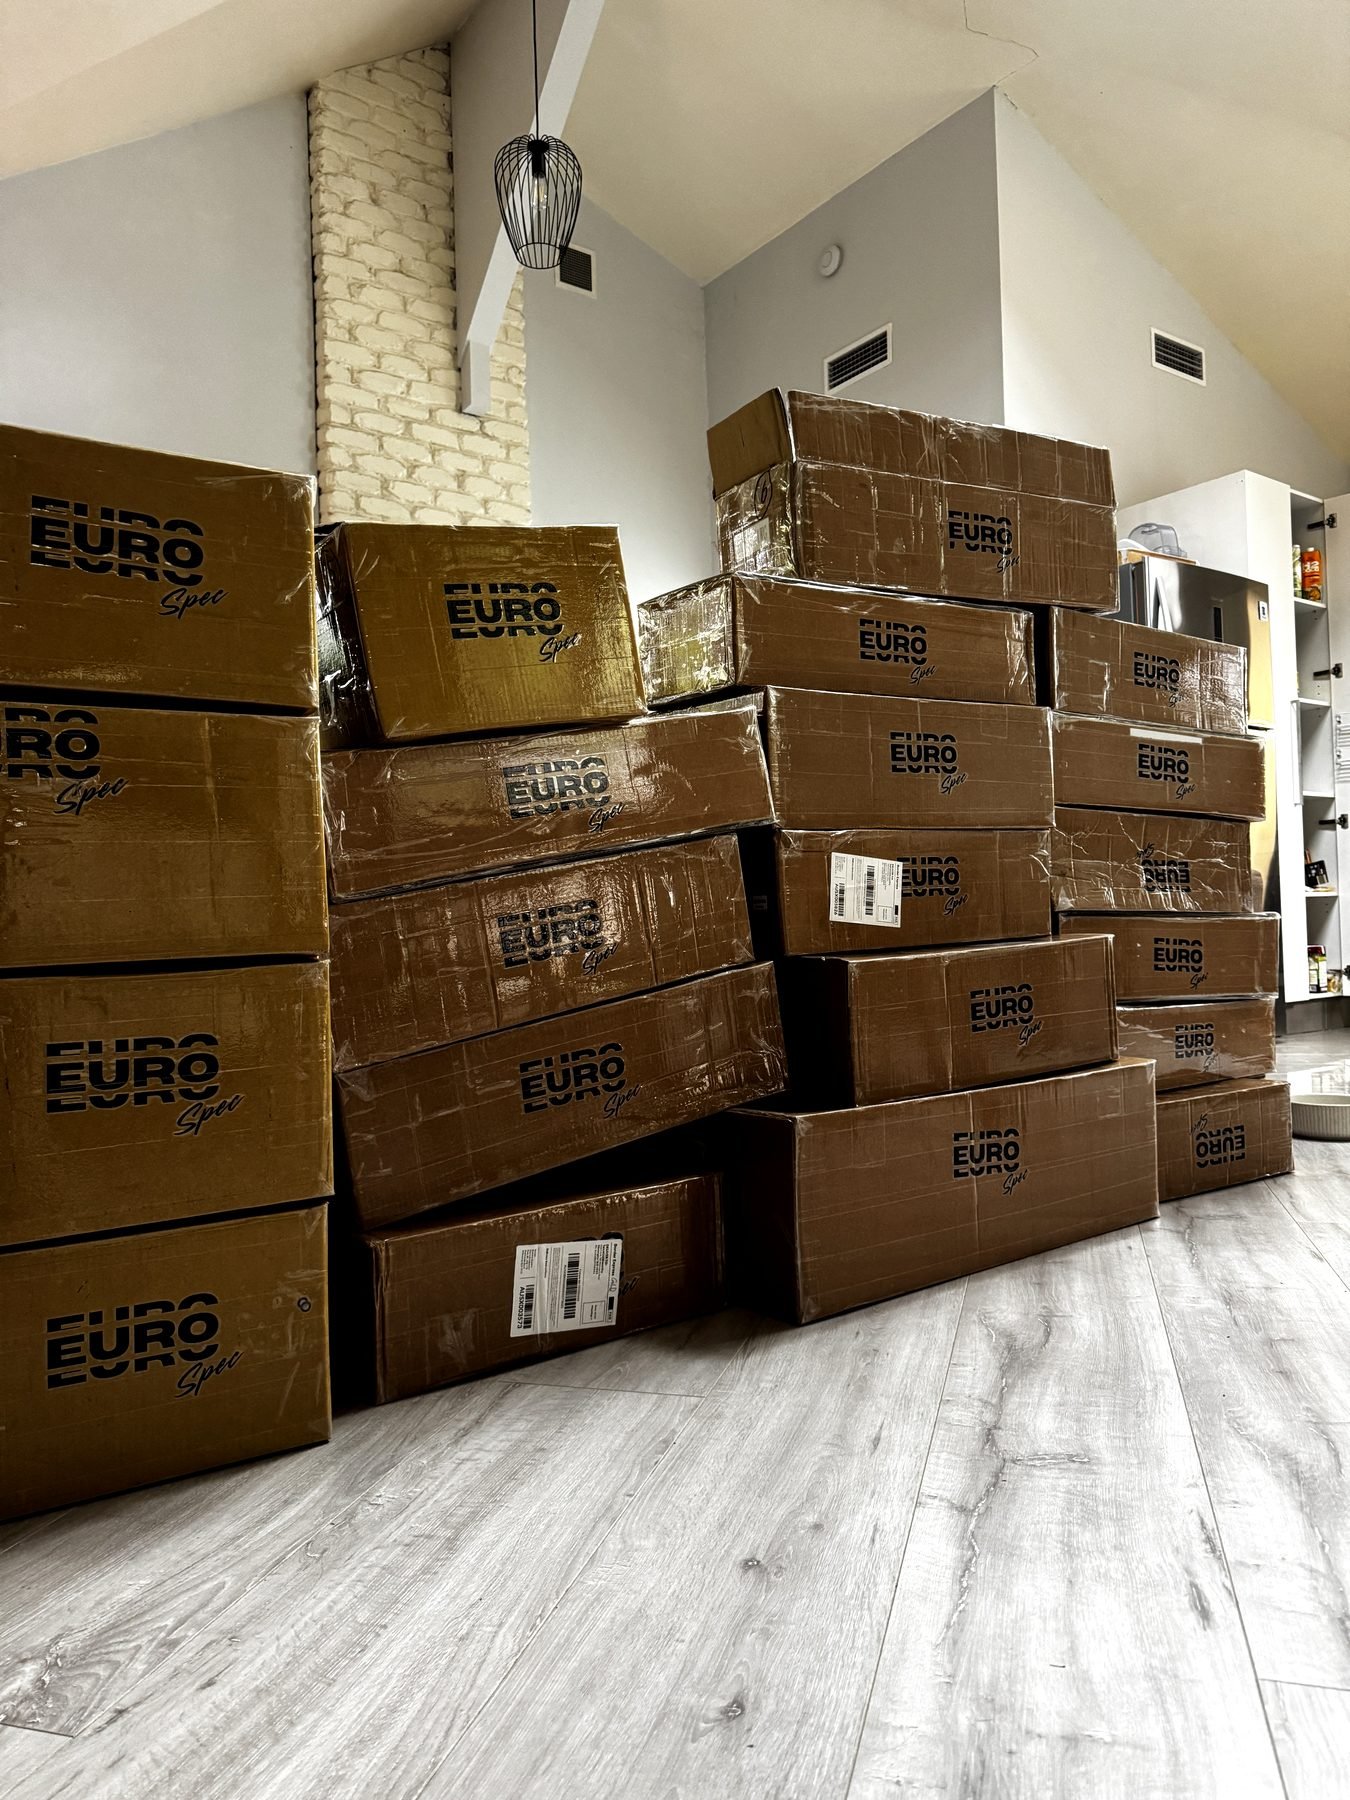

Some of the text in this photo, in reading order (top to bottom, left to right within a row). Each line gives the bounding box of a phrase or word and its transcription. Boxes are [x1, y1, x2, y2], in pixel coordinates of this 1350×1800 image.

[30, 515, 204, 569] EURO
[948, 521, 1013, 546] EURO
[158, 587, 230, 620] Spec
[446, 596, 562, 626] EURO
[538, 631, 582, 663] Spec
[859, 629, 928, 656] EURO
[909, 665, 936, 686] Spec
[1133, 661, 1180, 684] EURO
[890, 743, 958, 765] EURO
[1137, 753, 1189, 775] EURO
[53, 777, 129, 816] Spec
[504, 770, 610, 806] EURO
[940, 773, 967, 795] Spec
[1175, 783, 1197, 801] Spec
[587, 803, 626, 834] Spec
[902, 866, 960, 888] EURO
[943, 893, 969, 917] Spec
[499, 912, 602, 955] EURO
[582, 942, 620, 976] Spec
[1153, 946, 1204, 966] EURO
[970, 995, 1034, 1022] EURO
[1018, 1019, 1043, 1047] Spec
[1175, 1031, 1215, 1051] EURO
[45, 1051, 220, 1095] EURO
[519, 1055, 626, 1101] EURO
[174, 1093, 246, 1137] Spec
[603, 1083, 643, 1120] Spec
[953, 1139, 1020, 1166] EURO
[1195, 1134, 1245, 1159] EURO
[1002, 1168, 1028, 1196] Spec
[45, 1310, 220, 1370] EURO
[174, 1350, 246, 1399] Spec
